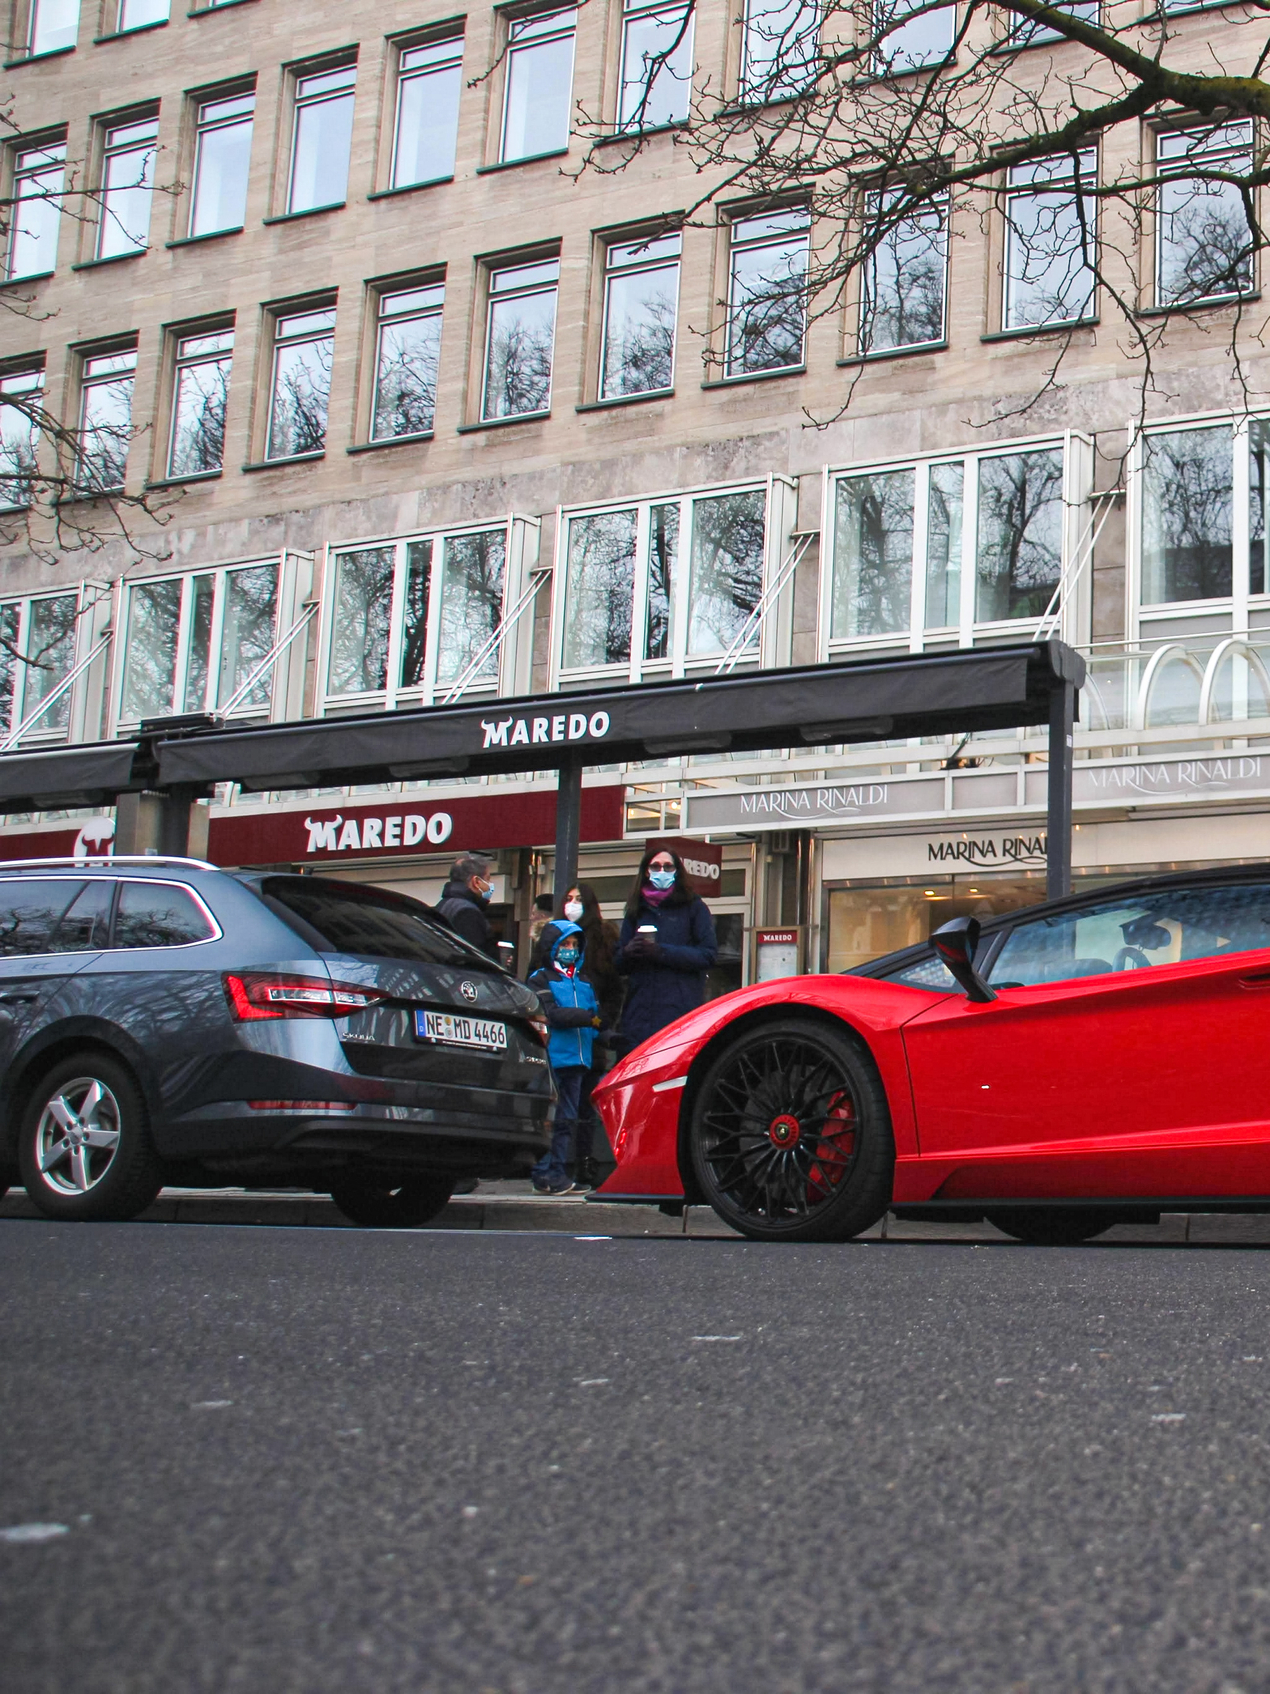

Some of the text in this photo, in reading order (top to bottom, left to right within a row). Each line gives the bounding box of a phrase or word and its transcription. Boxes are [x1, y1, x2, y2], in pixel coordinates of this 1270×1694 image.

[481, 711, 610, 748] MAREDO
[1087, 757, 1261, 793] MARINA RINALDI
[740, 784, 888, 818] MARINA RINALDI
[304, 812, 453, 852] MAREDO
[928, 839, 997, 866] MARINA
[763, 934, 793, 942] MAREDO
[426, 1014, 445, 1036] NE
[453, 1018, 471, 1040] MD
[474, 1021, 505, 1045] 4466
